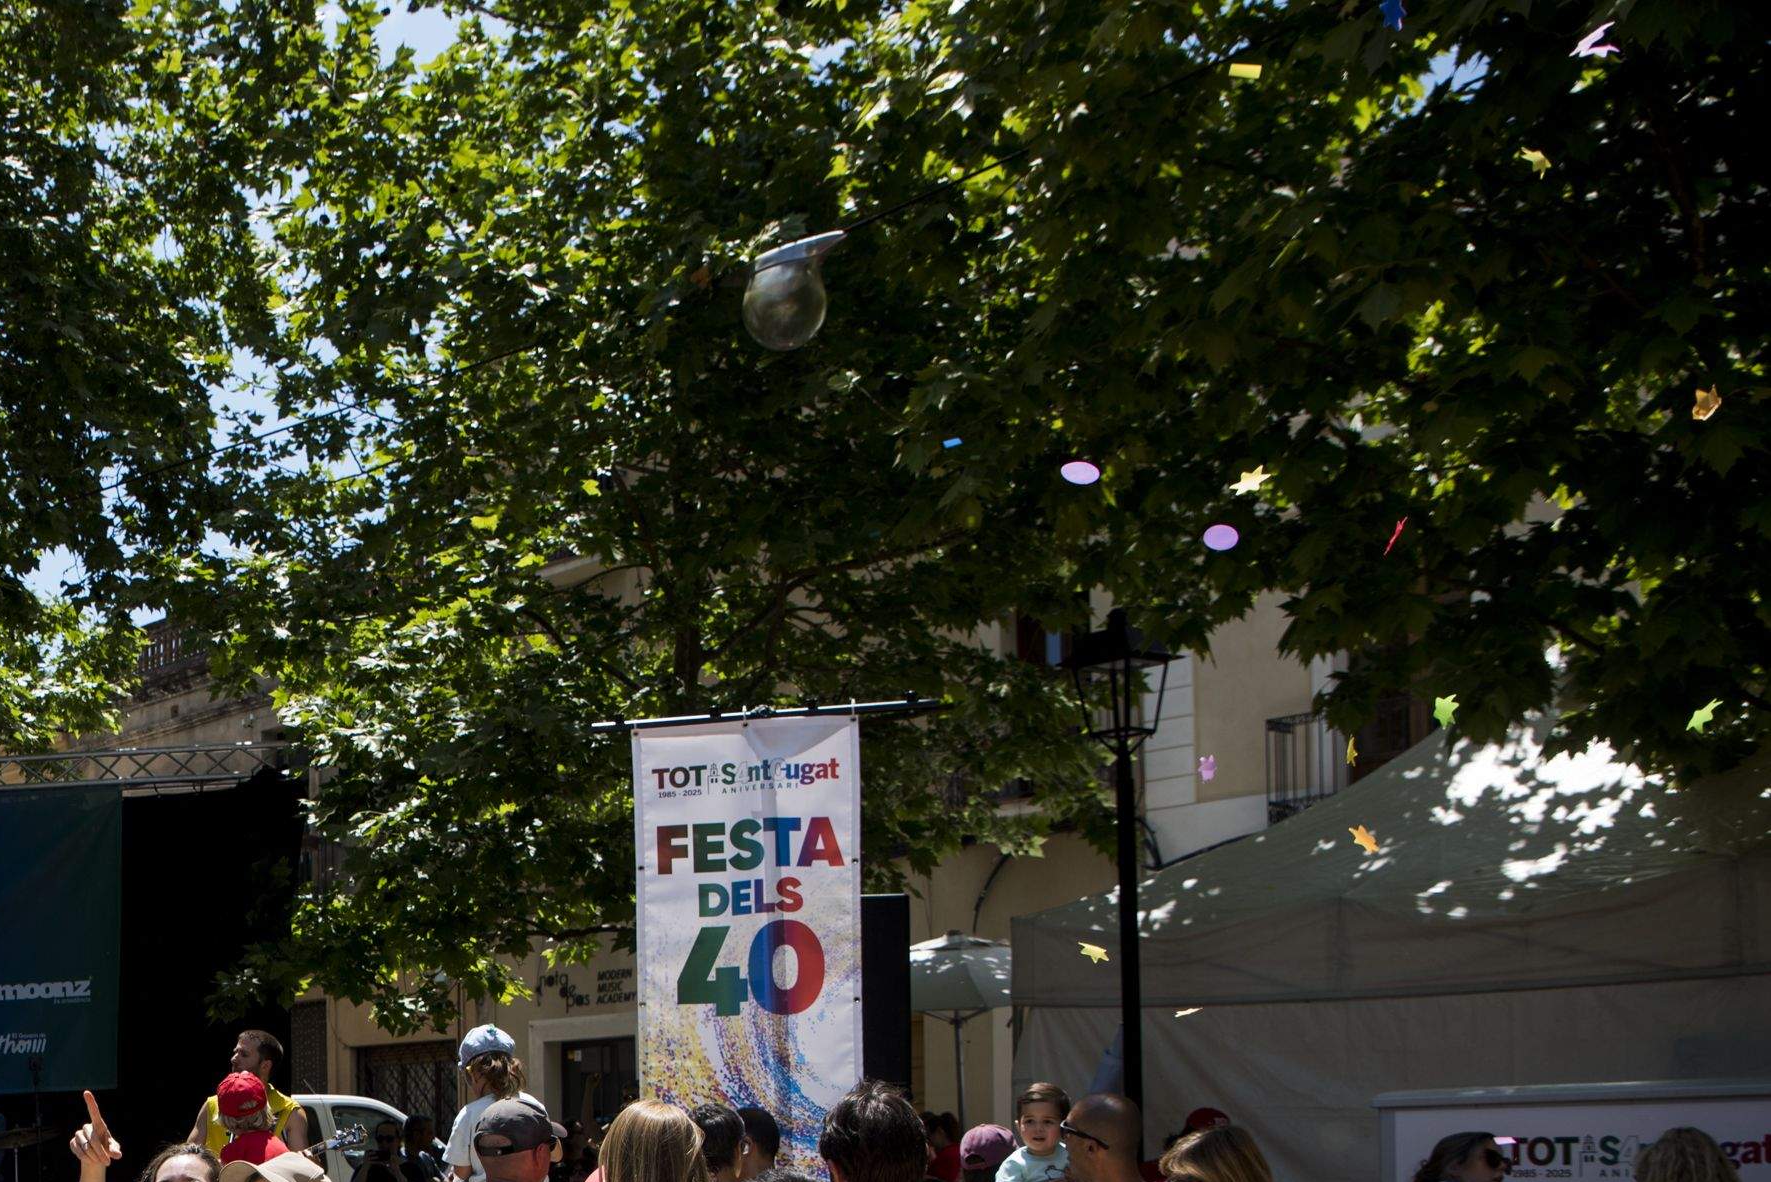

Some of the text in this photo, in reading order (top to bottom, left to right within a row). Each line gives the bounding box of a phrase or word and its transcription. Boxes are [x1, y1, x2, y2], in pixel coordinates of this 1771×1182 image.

[652, 765, 707, 789] TOT
[658, 790, 676, 799] 1985
[683, 788, 702, 797] 2025
[722, 782, 799, 794] ANIVERSARI
[656, 817, 844, 875] FESTA
[698, 877, 803, 917] DELS
[677, 919, 825, 1016] 40
[598, 968, 632, 981] MODERN
[598, 981, 623, 992] MUSIC
[596, 991, 637, 1004] ACADEMY
